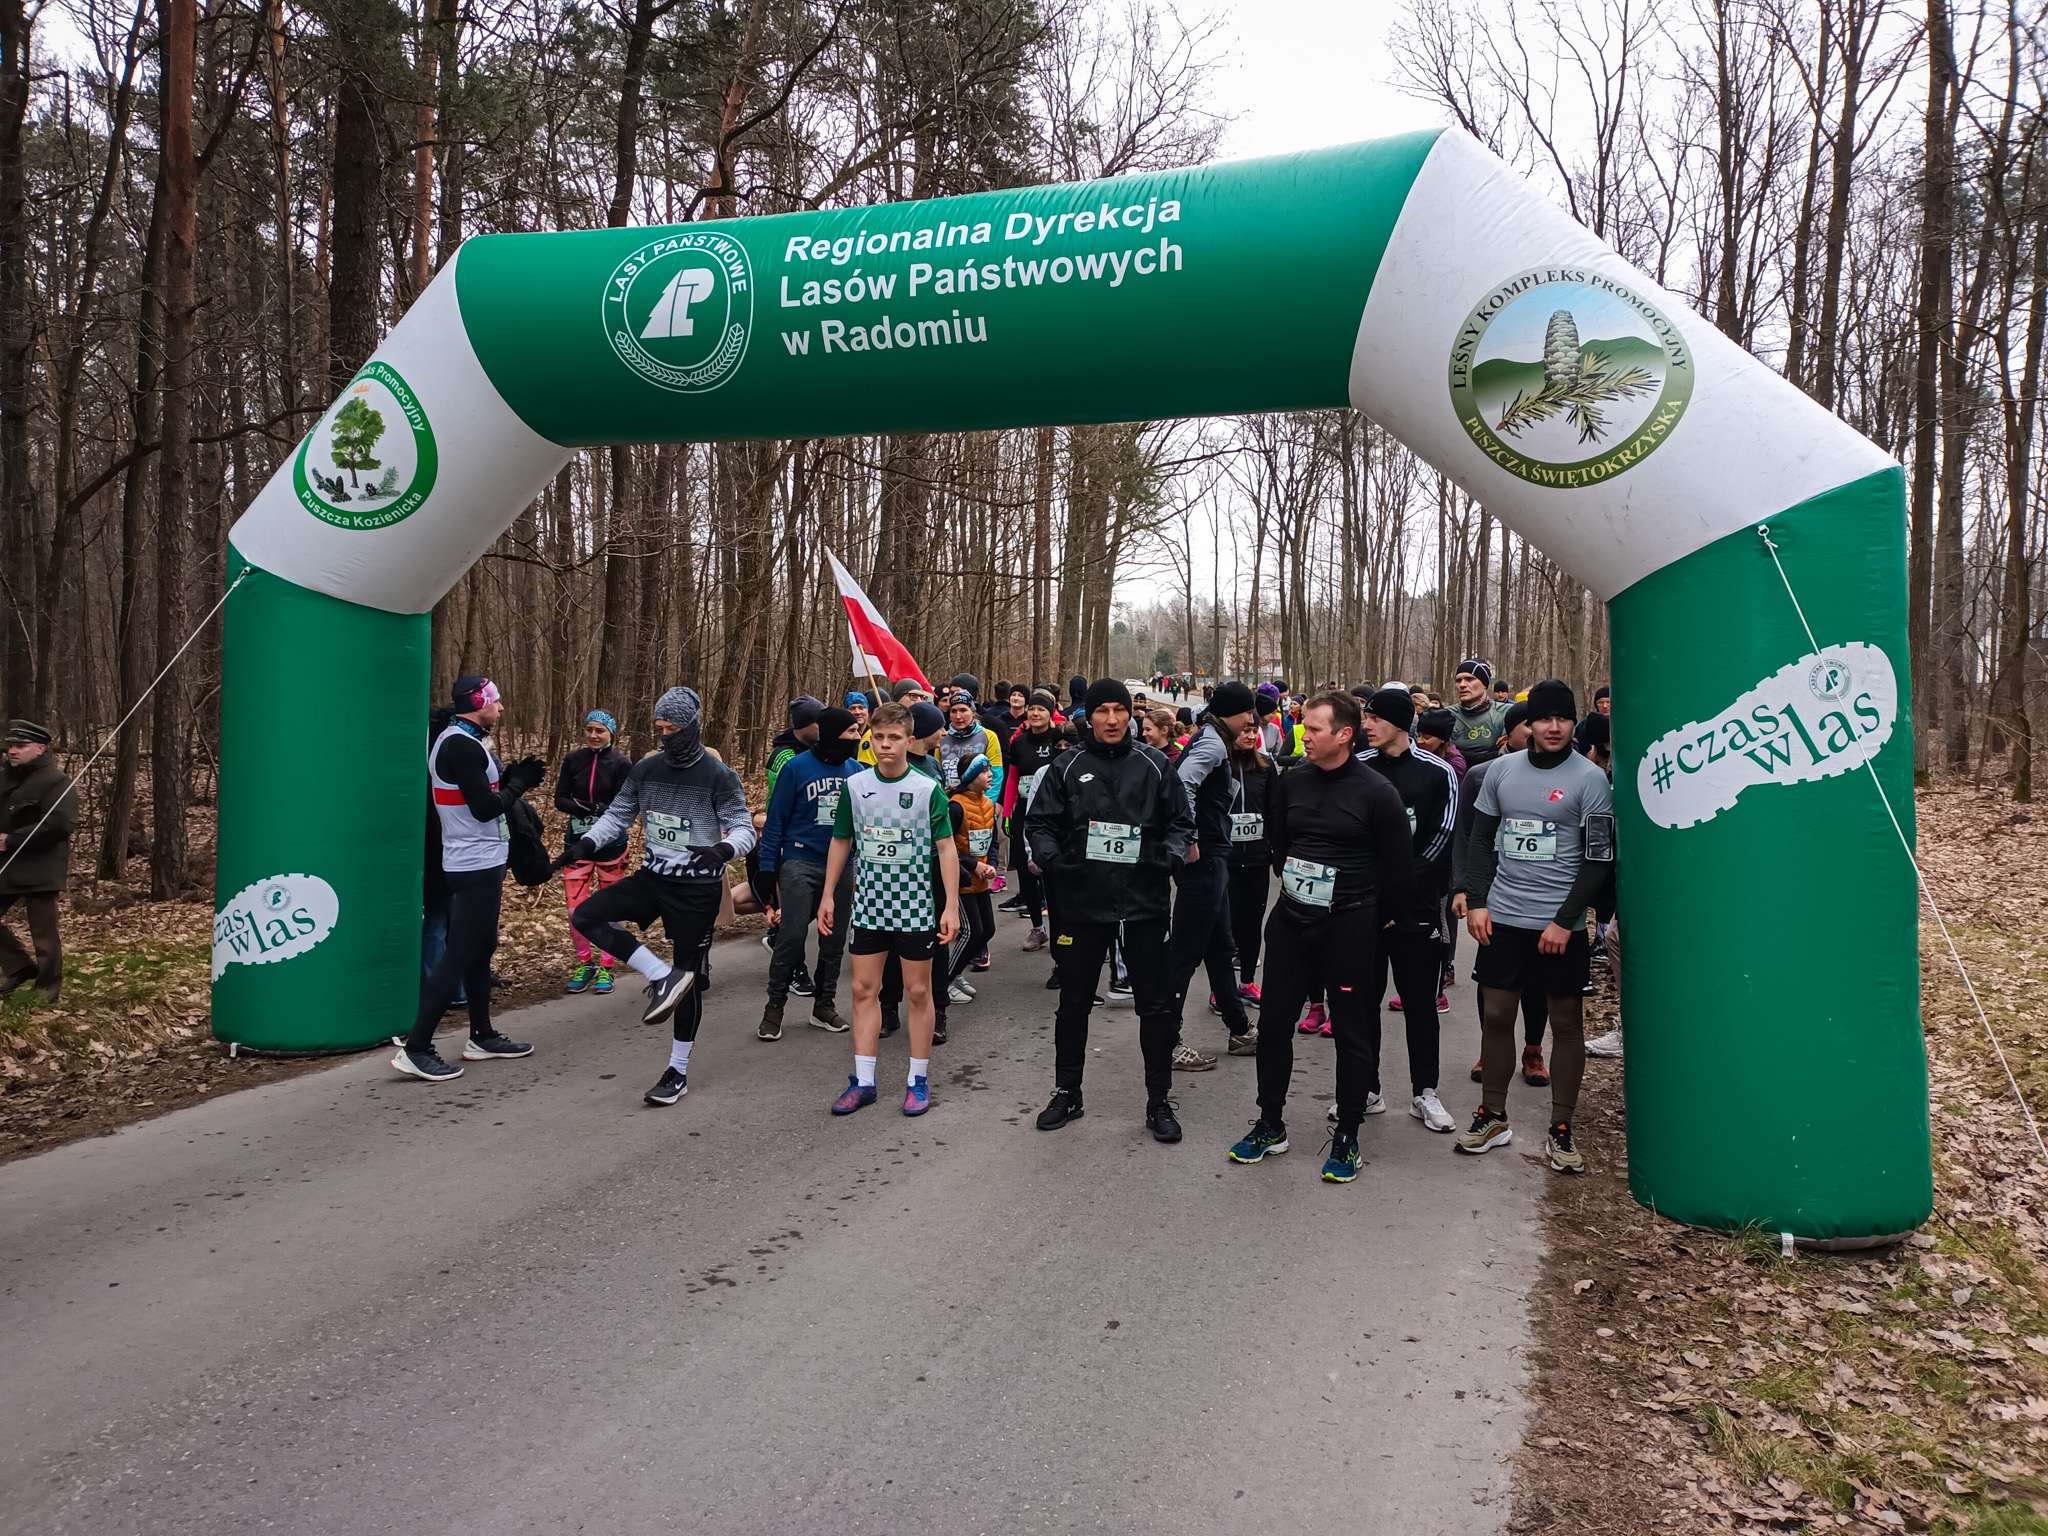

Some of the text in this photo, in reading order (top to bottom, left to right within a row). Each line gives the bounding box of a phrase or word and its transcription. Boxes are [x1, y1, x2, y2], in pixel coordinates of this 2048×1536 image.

[784, 198, 1182, 266] Regionalna Dyrekcja
[609, 234, 747, 302] LASY PAŃSTWOWE
[780, 237, 1184, 308] Lasów Państwowych
[782, 310, 989, 355] w Radomiu
[1453, 269, 1687, 390] LEŚNY KOMPLEKS PROMOCYJNY
[375, 365, 426, 431] Promocyjny
[1465, 399, 1683, 488] PUSZCZA ŚWIĘTOKRZYSKA
[301, 489, 423, 528] Puszcza Kozienicka
[1651, 704, 1780, 794] #czas
[806, 776, 848, 802] DUFF
[658, 828, 676, 842] 90
[877, 843, 897, 857] 29
[1103, 839, 1124, 854] 18
[1234, 824, 1257, 836] 100
[1515, 836, 1538, 852] 76
[1295, 877, 1314, 895] 71
